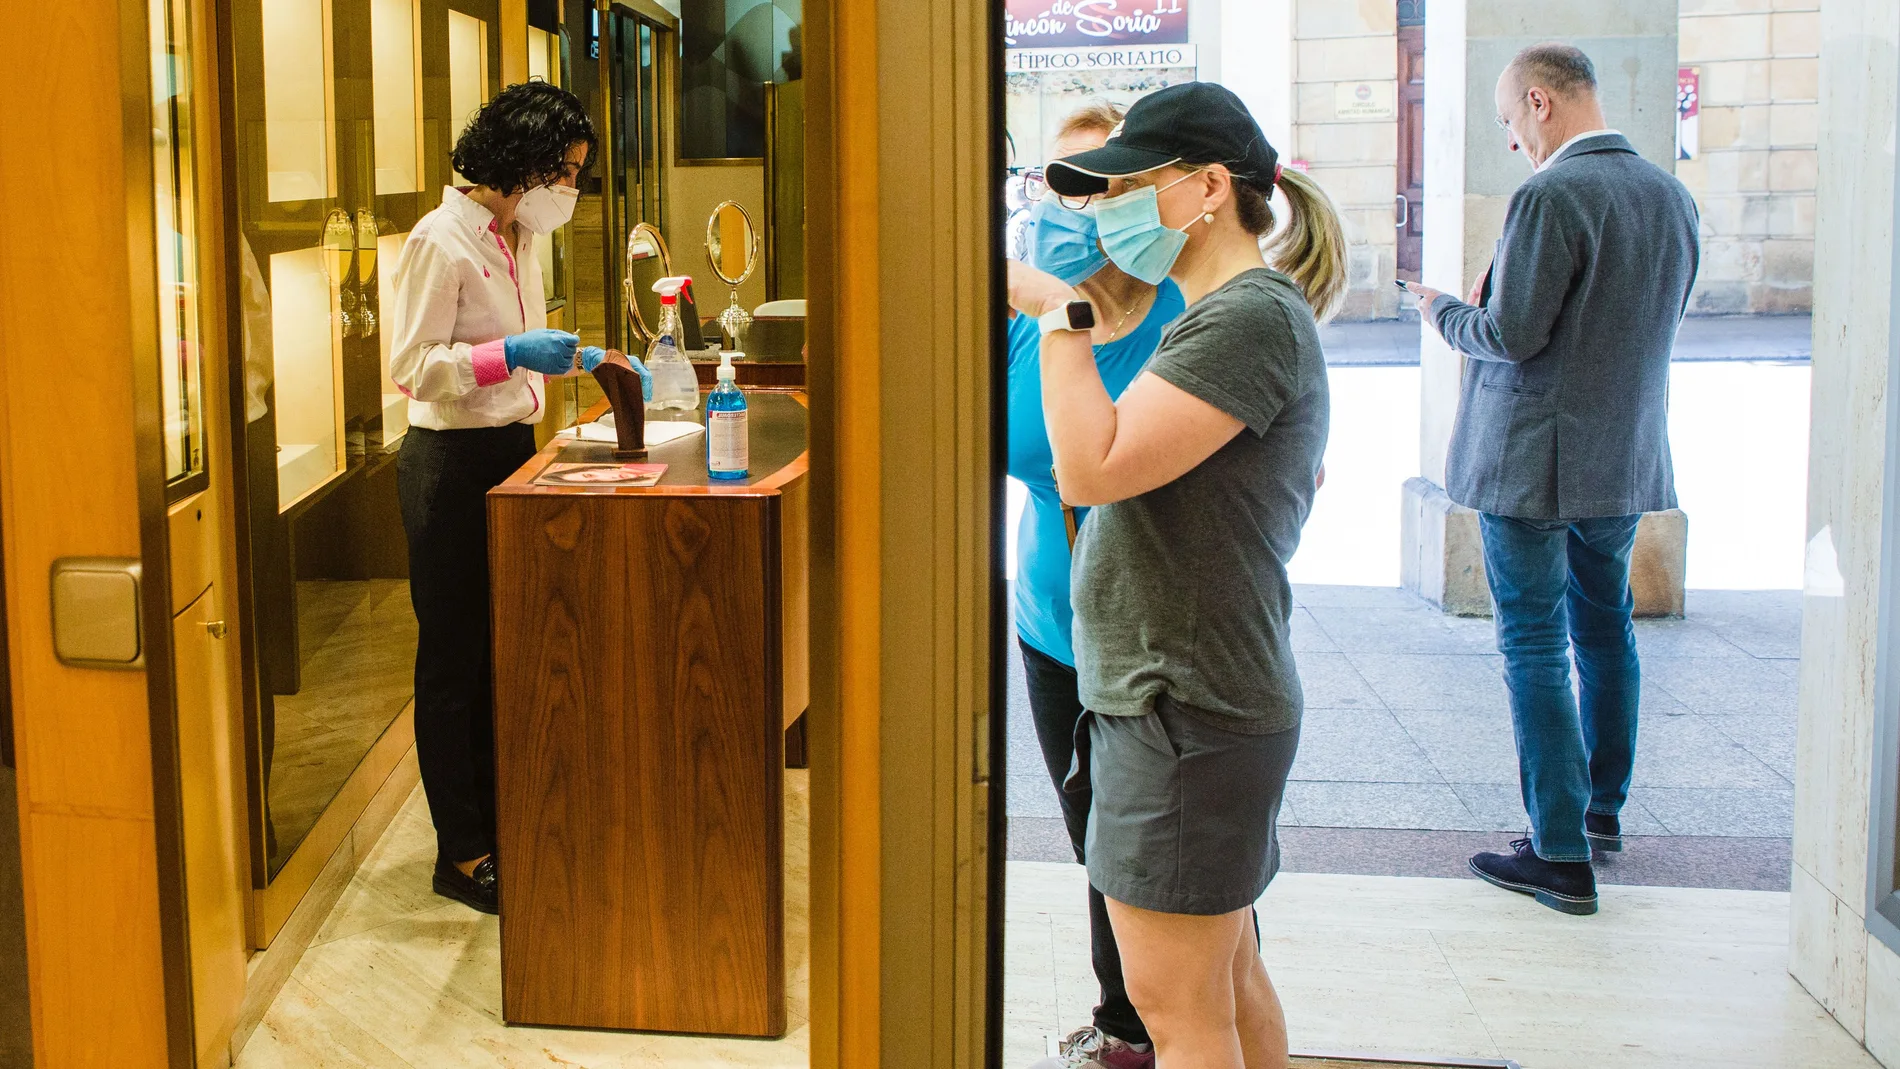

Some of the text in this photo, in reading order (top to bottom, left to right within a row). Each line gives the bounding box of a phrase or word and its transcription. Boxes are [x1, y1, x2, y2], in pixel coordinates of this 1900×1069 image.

[1005, 9, 1066, 45] incón
[1052, 0, 1073, 15] de
[1073, 0, 1161, 36] Soria
[1087, 50, 1182, 67] SORIANO
